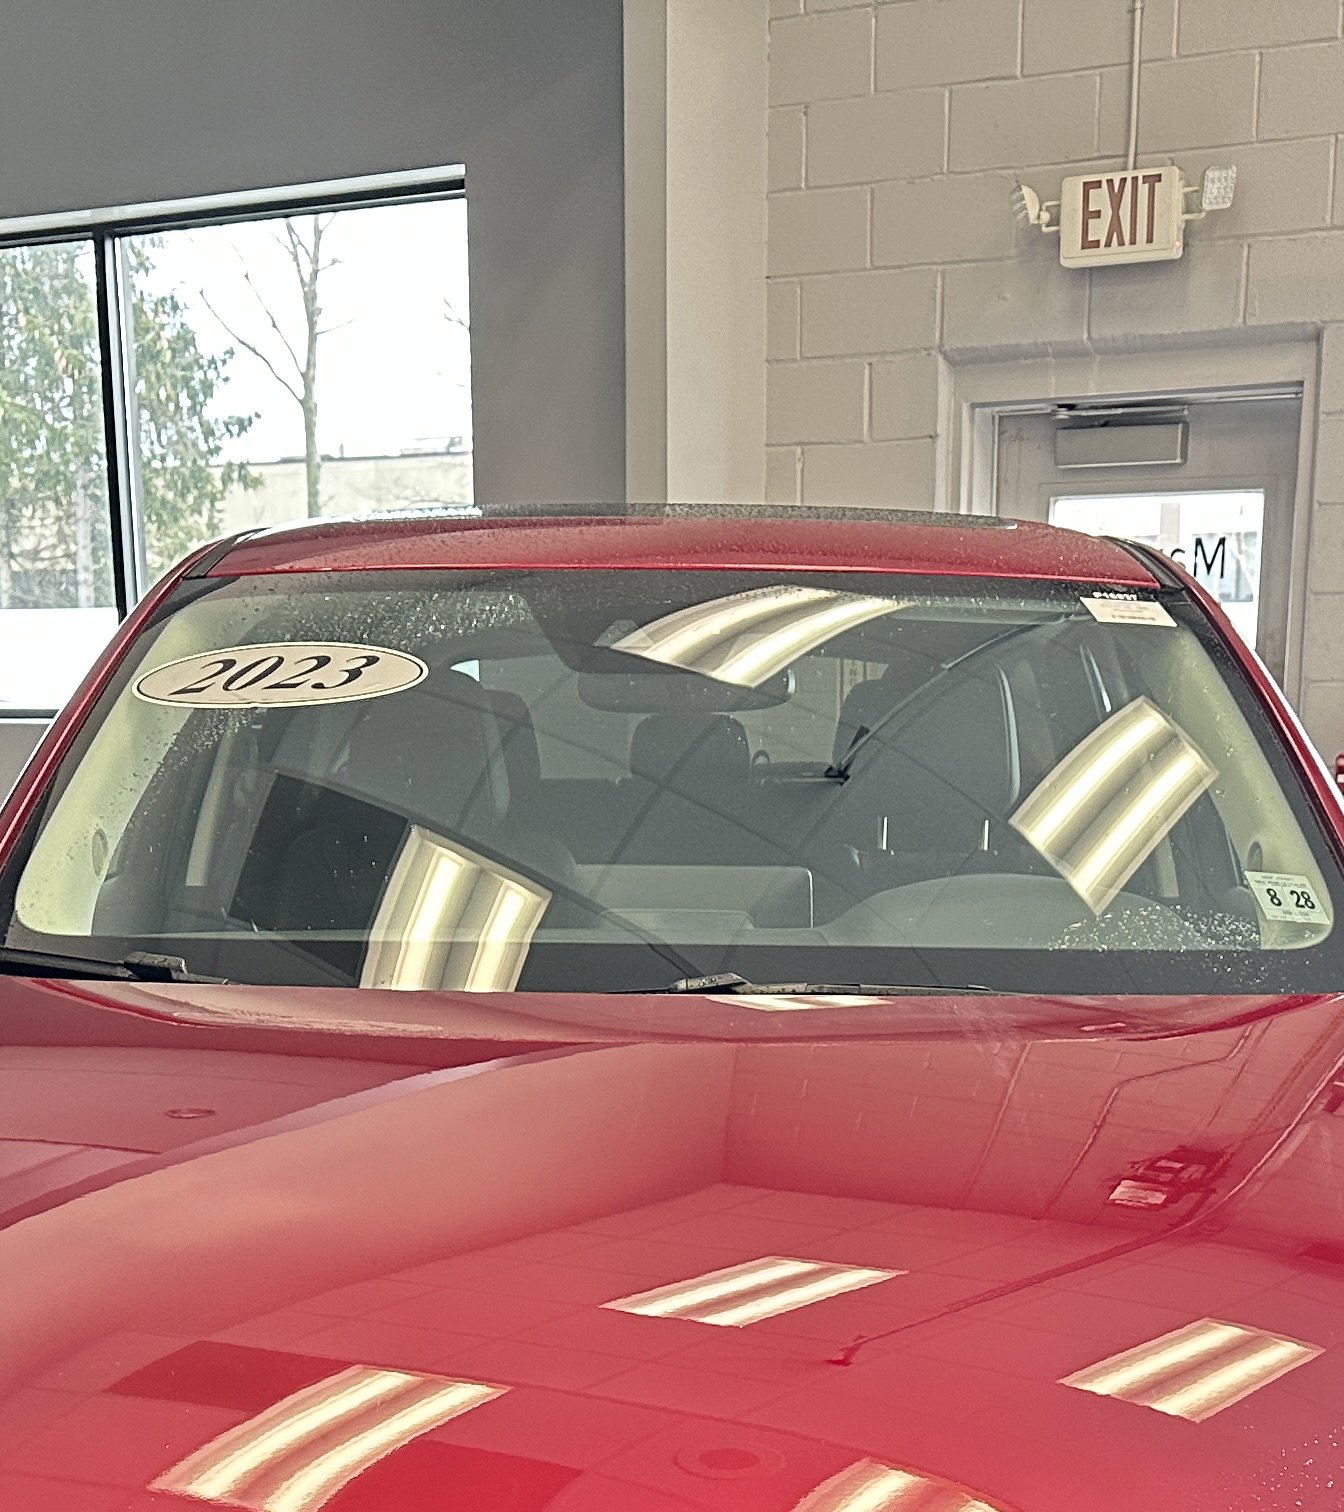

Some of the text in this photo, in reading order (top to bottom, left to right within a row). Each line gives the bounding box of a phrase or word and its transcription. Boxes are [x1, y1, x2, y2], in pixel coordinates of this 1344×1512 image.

[1080, 173, 1162, 250] EXIT
[168, 655, 381, 696] 2023
[1266, 888, 1316, 909] 8 28
